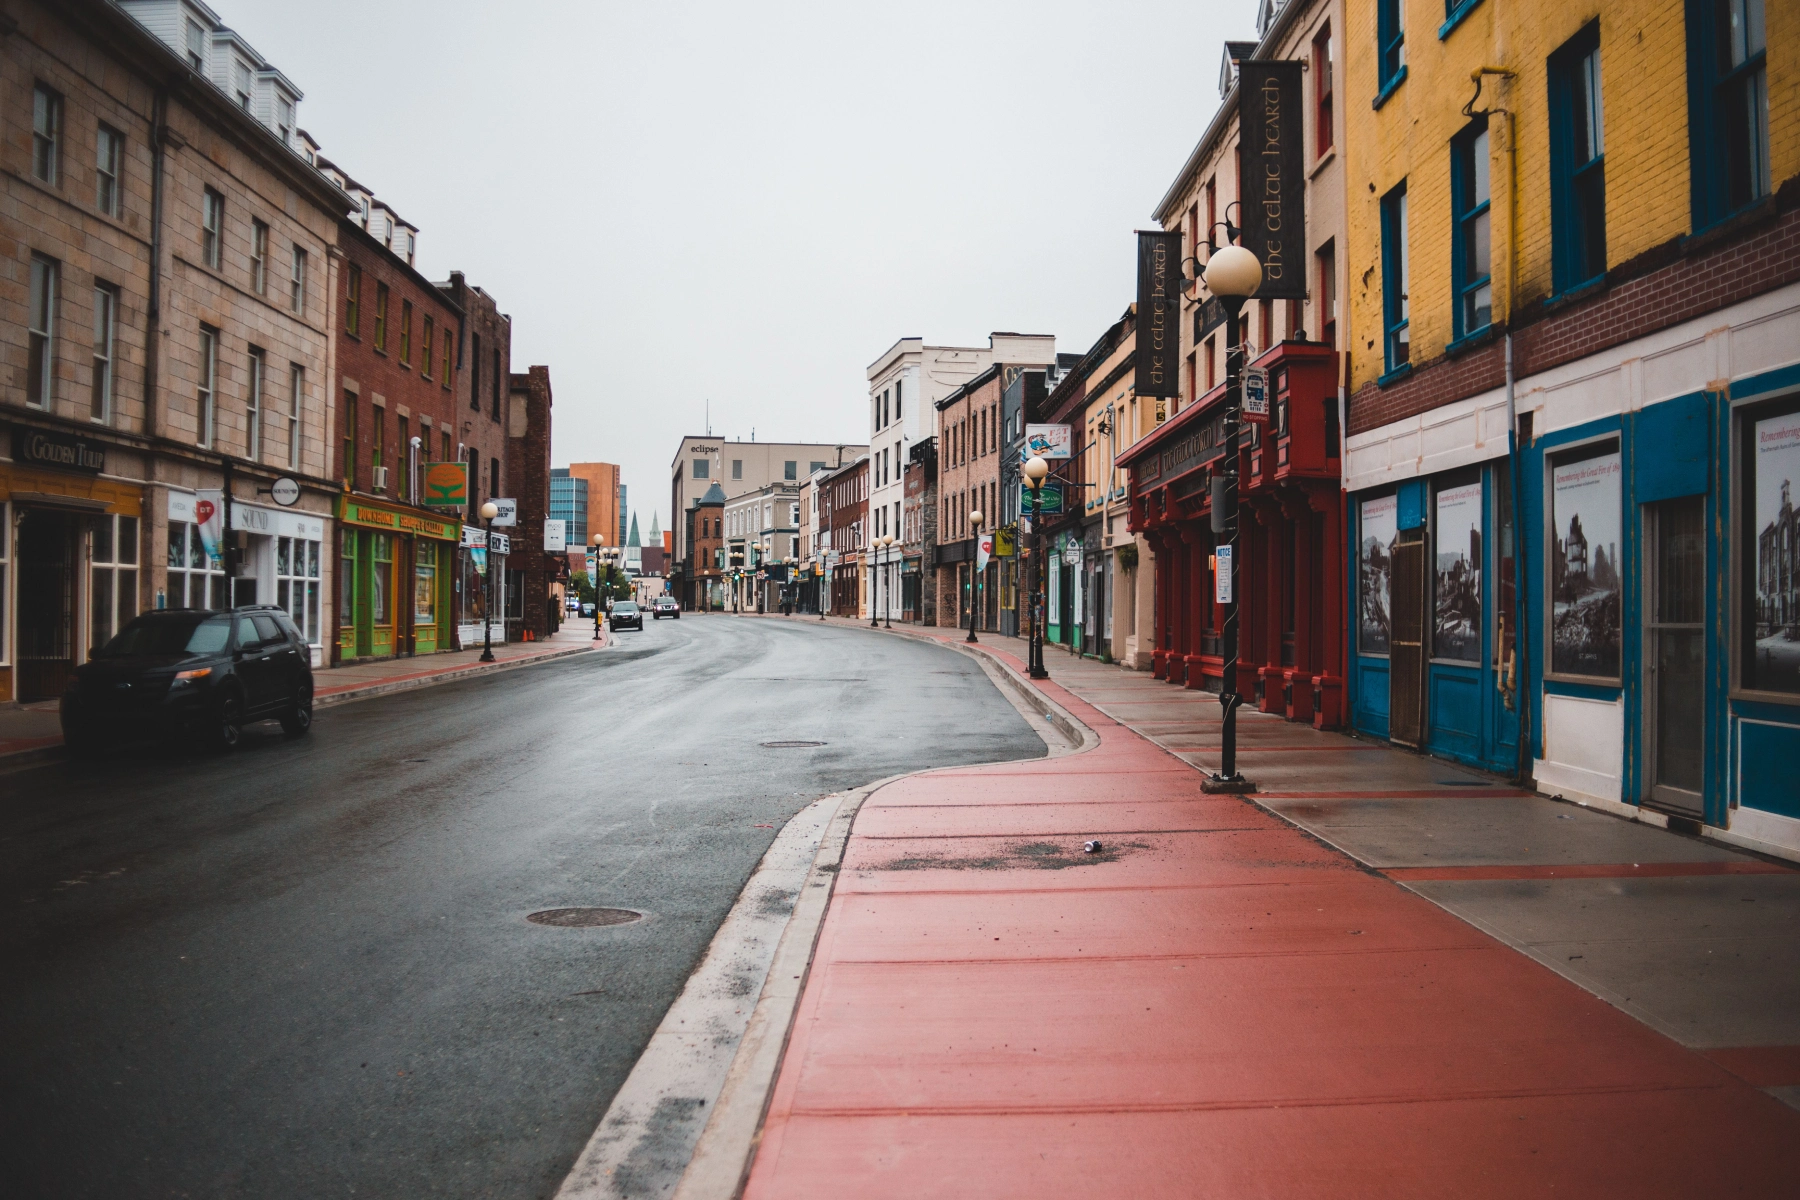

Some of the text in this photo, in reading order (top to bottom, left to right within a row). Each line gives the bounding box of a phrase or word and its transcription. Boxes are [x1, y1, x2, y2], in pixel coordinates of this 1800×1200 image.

[76, 442, 104, 468] TULIP
[691, 445, 719, 455] eclipse
[242, 508, 268, 530] SOUND
[358, 507, 394, 525] DOWNHOME
[425, 520, 445, 535] GALLERY
